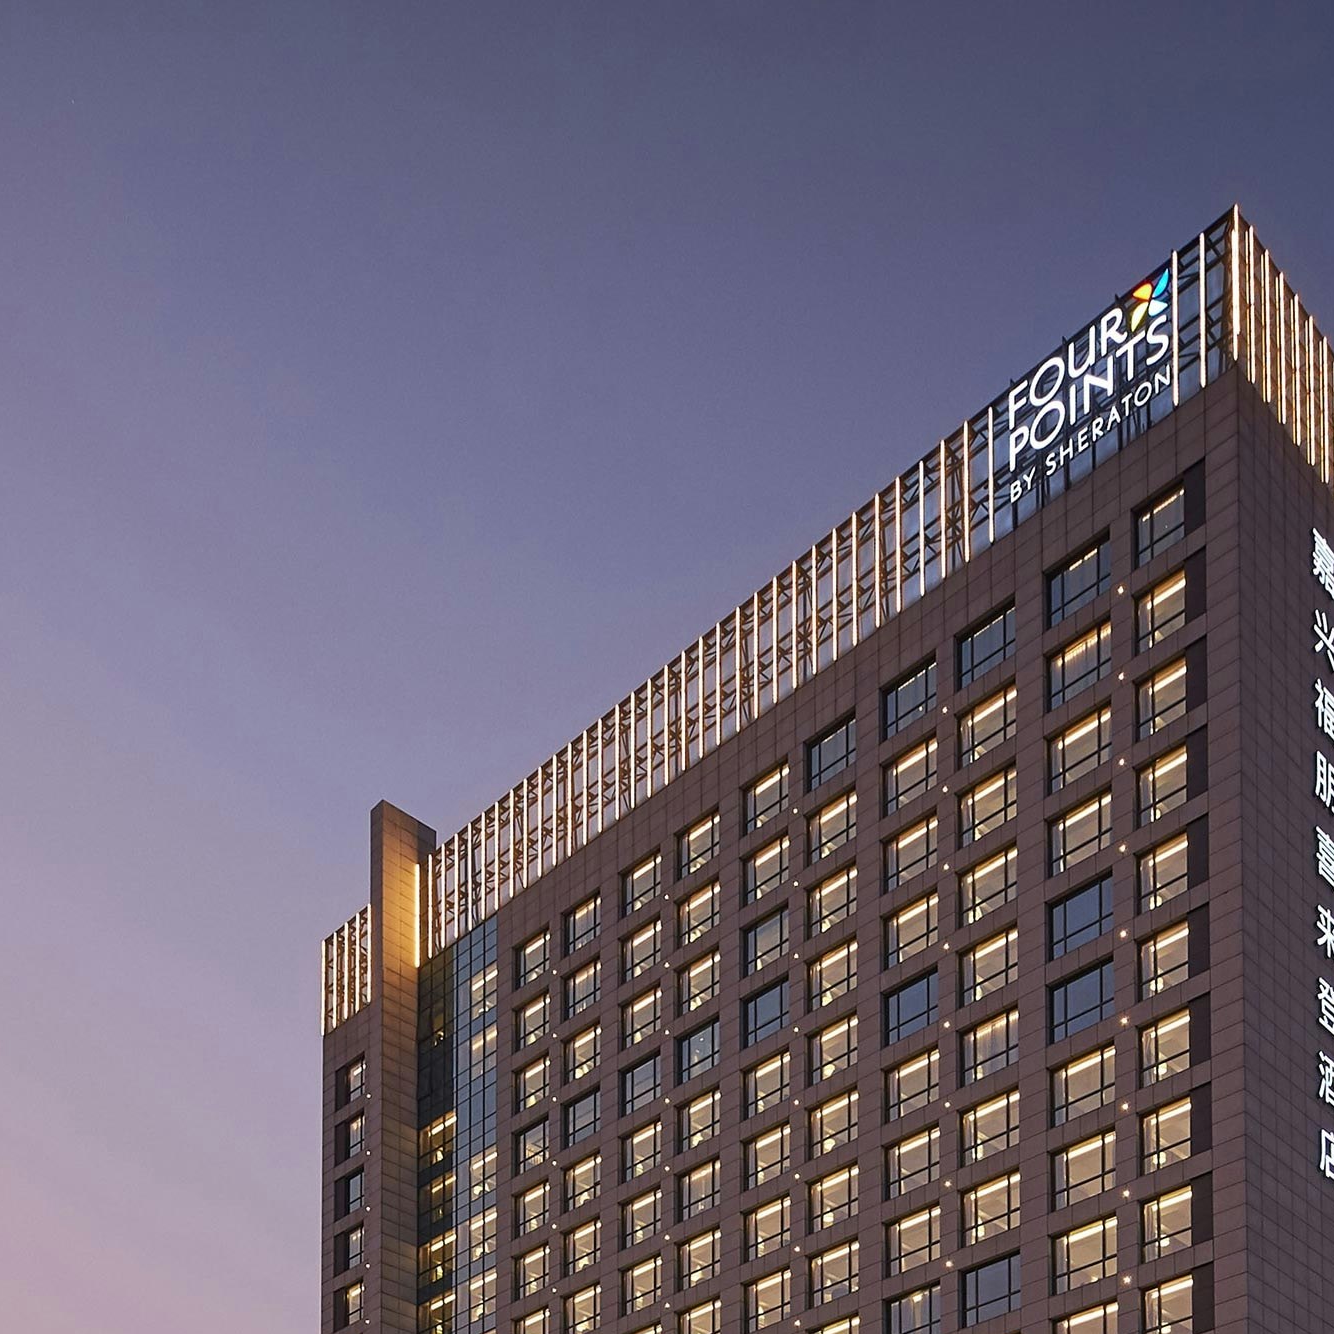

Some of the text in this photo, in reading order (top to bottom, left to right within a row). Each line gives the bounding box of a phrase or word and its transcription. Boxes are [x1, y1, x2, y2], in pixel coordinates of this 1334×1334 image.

[1009, 307, 1128, 431] FOUR
[1009, 314, 1170, 473] POINTS
[1010, 363, 1171, 504] BY SHERATON
